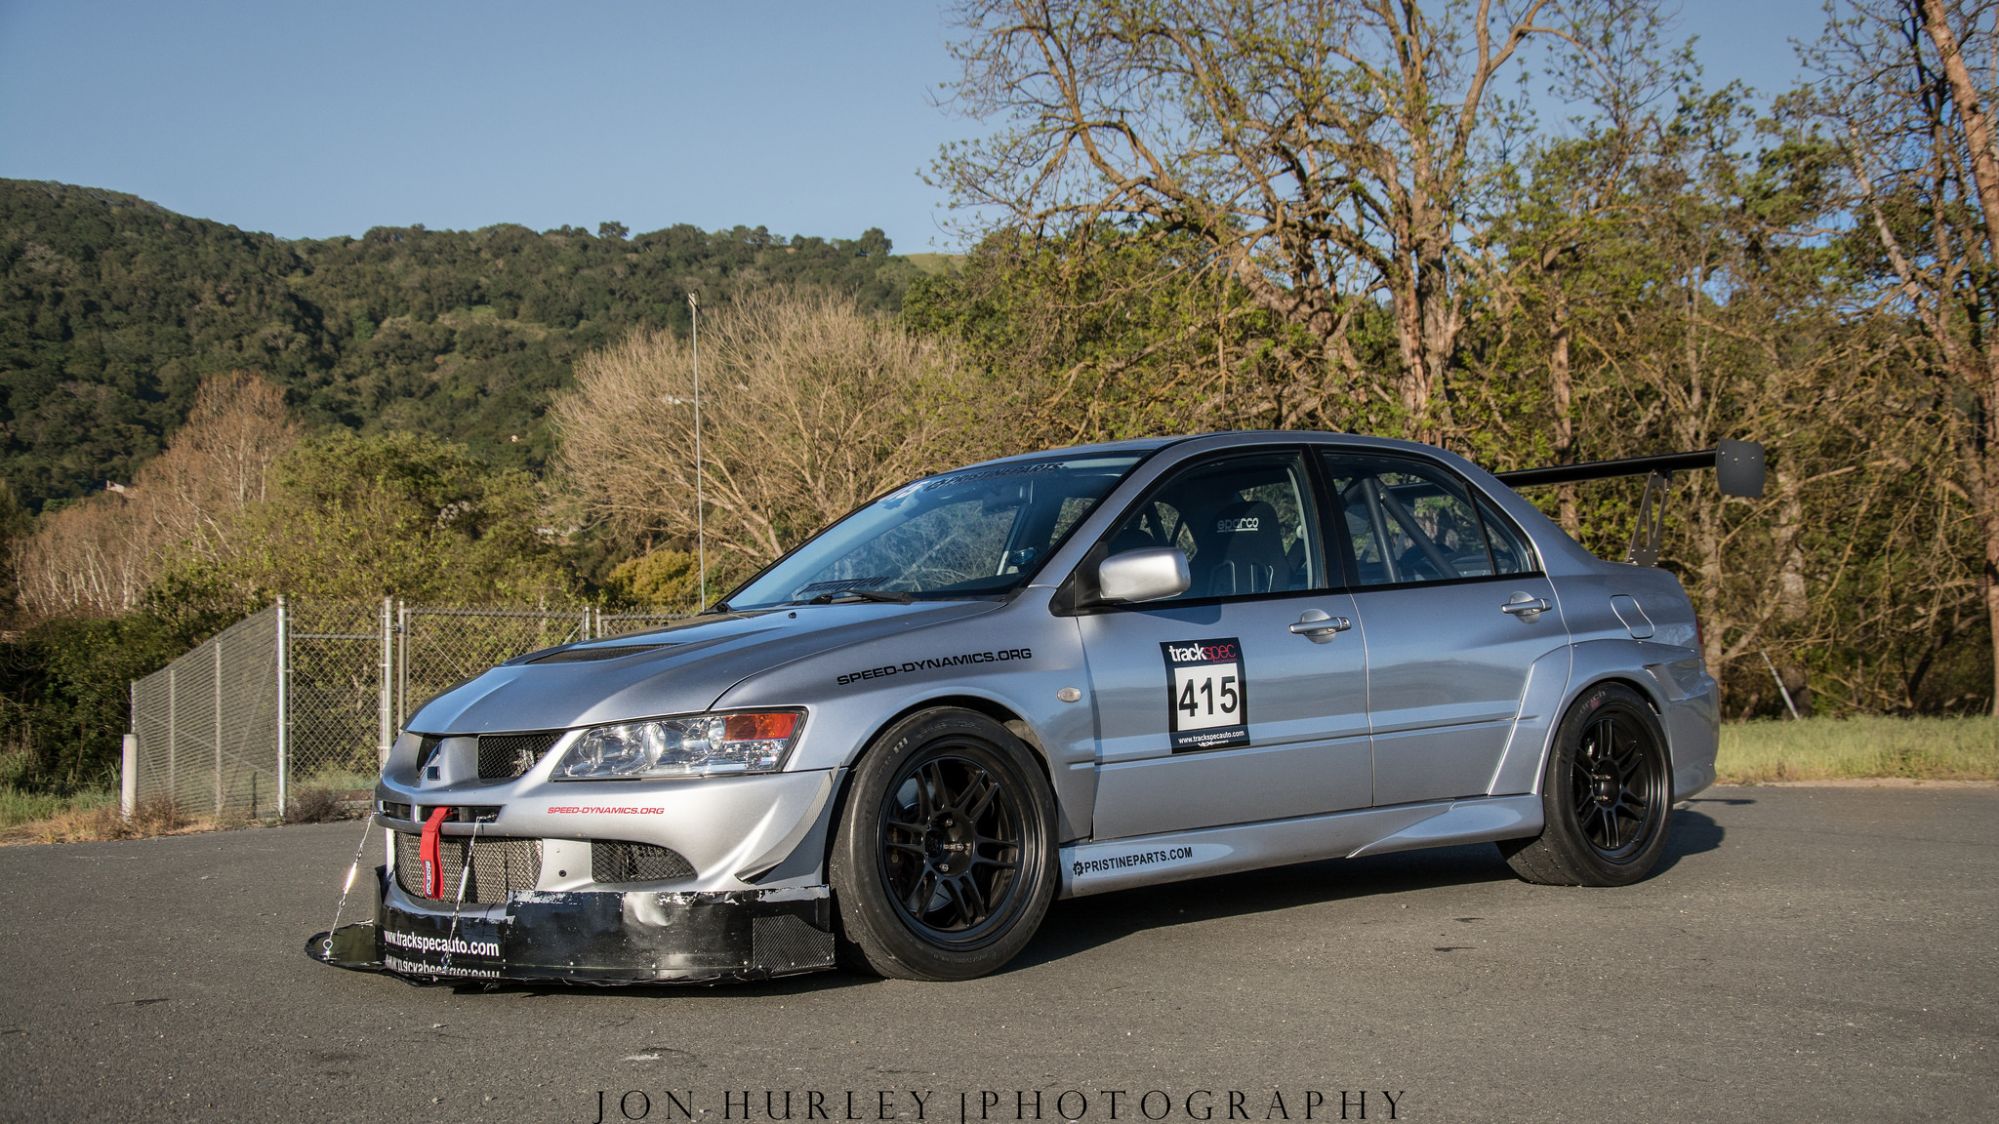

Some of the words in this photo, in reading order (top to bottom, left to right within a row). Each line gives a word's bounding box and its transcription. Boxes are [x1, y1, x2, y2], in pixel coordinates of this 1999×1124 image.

[1169, 643, 1237, 662] trackspec
[837, 648, 1032, 686] SPEED-DYNAMICS.ORG
[1178, 675, 1238, 717] 415
[1178, 730, 1245, 744] www.trackspecauto.com
[547, 806, 665, 815] SPEED-DYNAMICS.ORG
[1084, 846, 1193, 873] PRISTINEPARTS.COM
